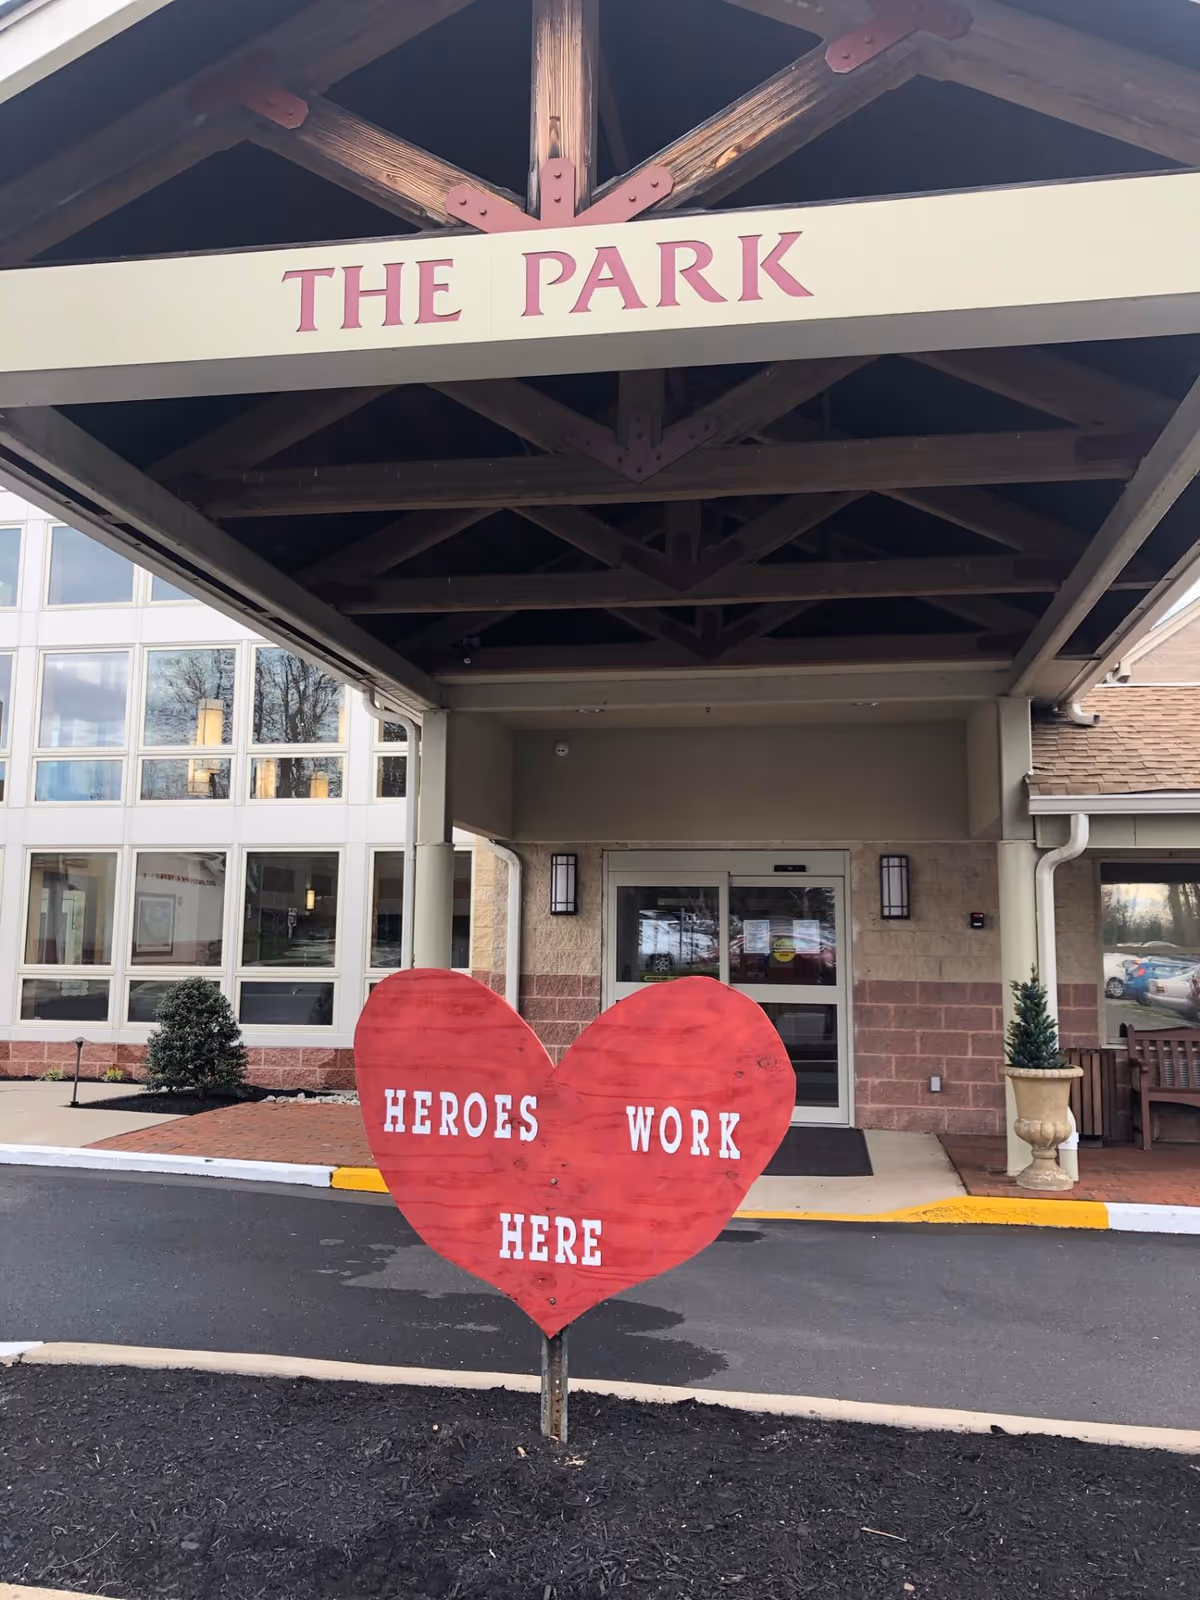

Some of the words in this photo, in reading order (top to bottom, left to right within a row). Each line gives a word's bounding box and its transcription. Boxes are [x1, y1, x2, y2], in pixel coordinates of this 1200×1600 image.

[282, 258, 462, 332] THE
[522, 230, 813, 317] PARK
[383, 1088, 539, 1142] HEROES
[625, 1105, 741, 1160] WORK
[499, 1212, 603, 1267] HERE
